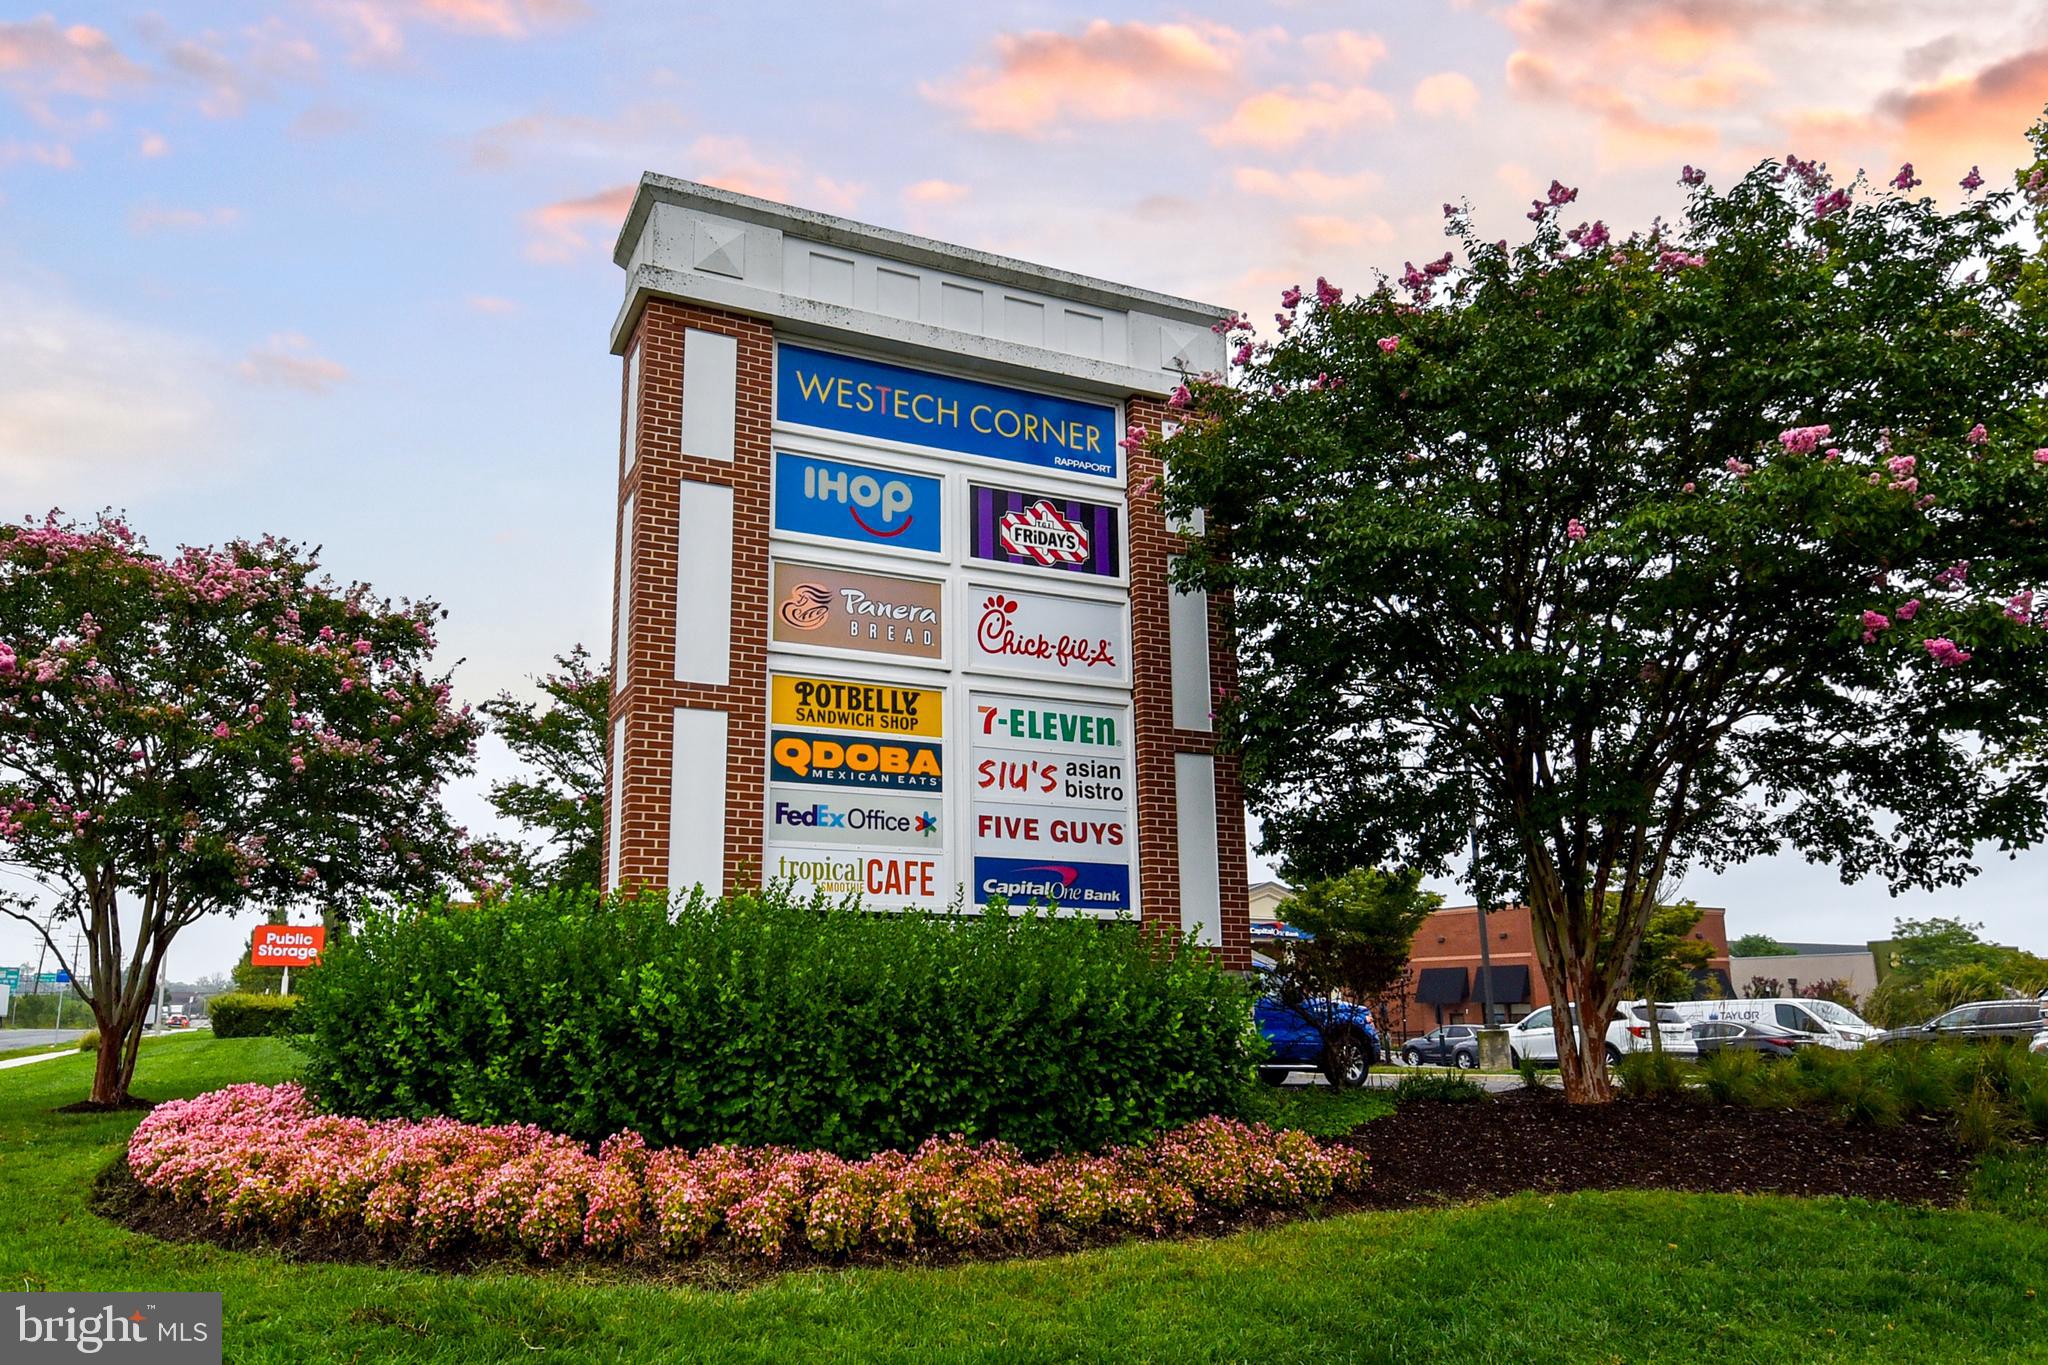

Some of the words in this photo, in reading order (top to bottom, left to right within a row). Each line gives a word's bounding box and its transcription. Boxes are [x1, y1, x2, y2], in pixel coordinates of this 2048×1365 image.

[796, 370, 958, 428] WESTECH
[970, 404, 1101, 454] CORNER
[1054, 456, 1112, 474] RAPPAPORT
[840, 588, 937, 625] Panera
[850, 620, 935, 647] BREAD
[977, 604, 1117, 667] Chick-fil-A
[794, 681, 921, 717] POTBELLY
[796, 706, 875, 729] SANDWICH
[880, 714, 919, 732] SHOP
[773, 737, 942, 777] QDOBA
[812, 769, 890, 785] MEXICAN
[897, 774, 938, 787] EATS
[1066, 760, 1122, 781] asian
[1064, 779, 1124, 802] bistro
[775, 801, 845, 829] FedEx
[847, 807, 911, 832] Office
[978, 815, 1039, 842] FIVE
[1050, 822, 1124, 847] GUYS
[778, 855, 864, 885] tropical
[867, 858, 935, 897] CAFE
[1084, 888, 1121, 902] Bank
[258, 944, 318, 960] Storage
[266, 933, 313, 945] Public
[1720, 1011, 1760, 1020] TAYLOR
